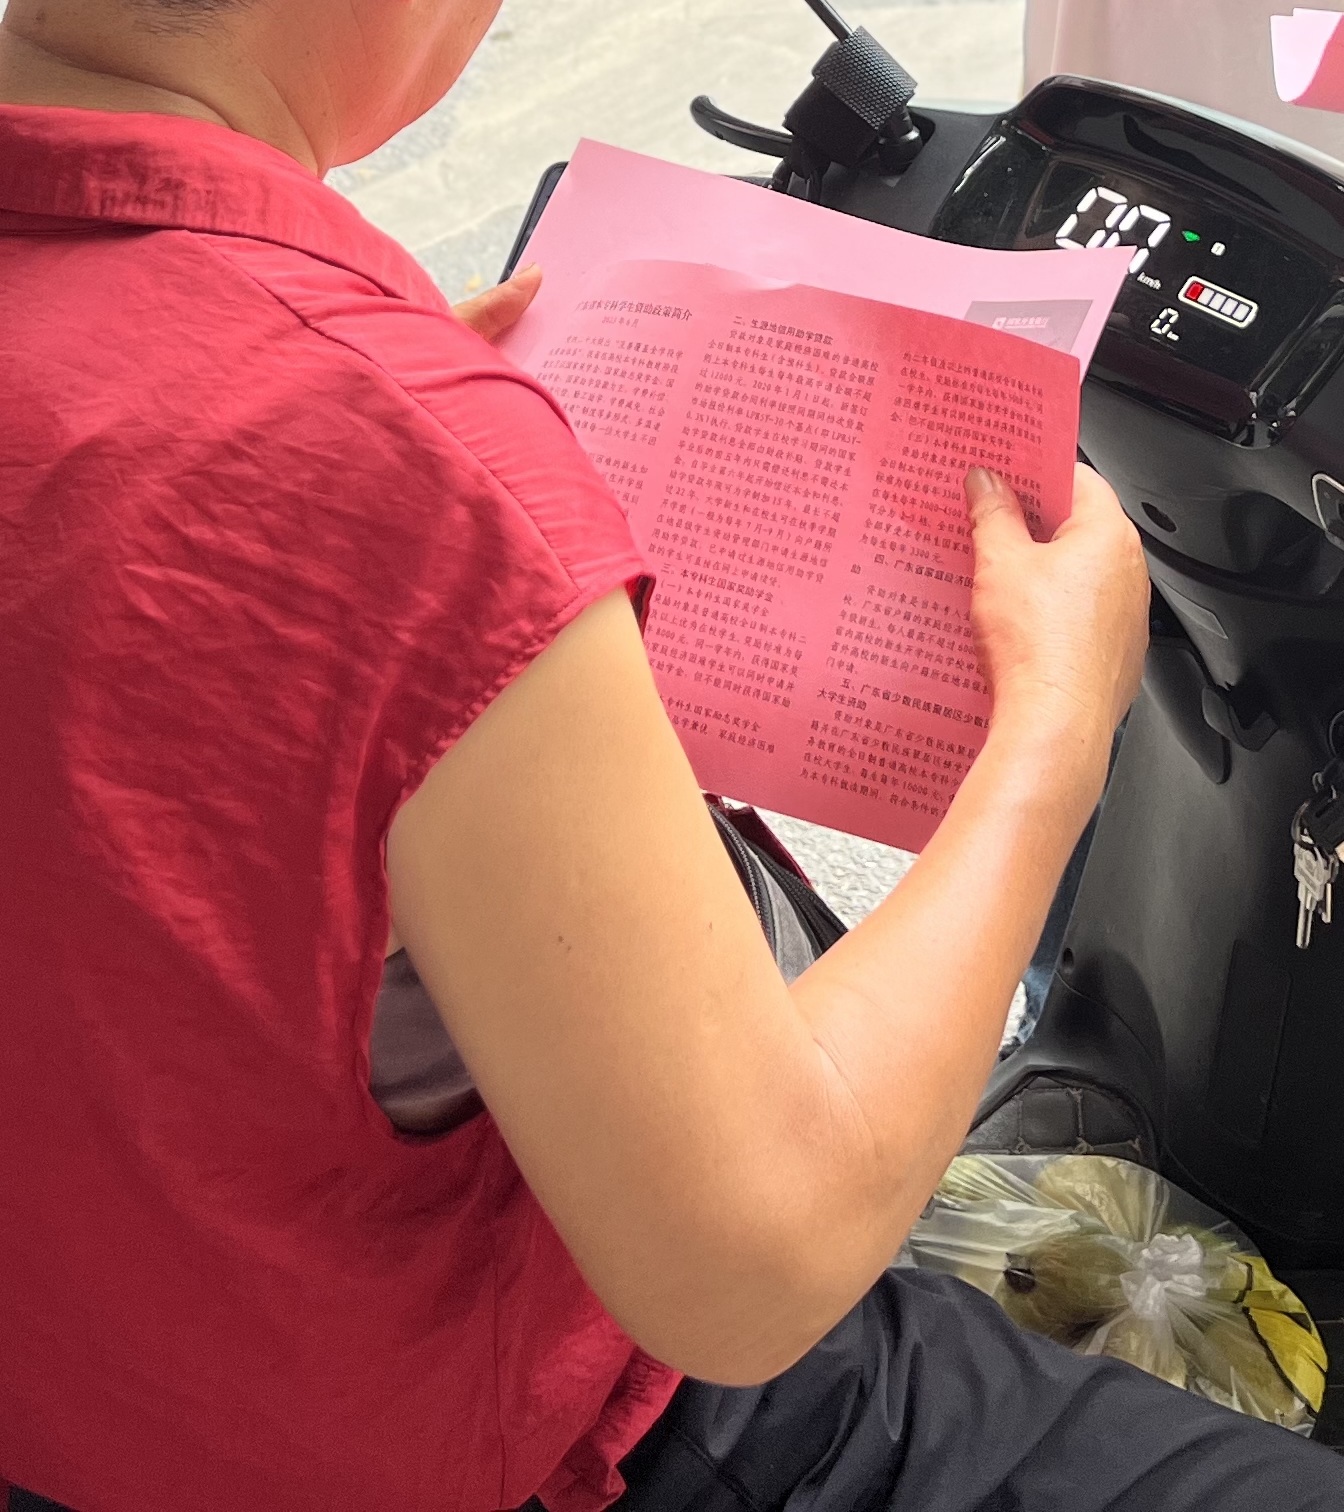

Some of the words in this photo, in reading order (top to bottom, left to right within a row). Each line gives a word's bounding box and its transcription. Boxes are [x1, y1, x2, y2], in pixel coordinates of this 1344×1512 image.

[600, 467, 645, 492] 在开学报
[660, 693, 762, 734] 专科生国家励志奖学金
[811, 719, 972, 775] 籍并在广东省少数民族聚居区接受
